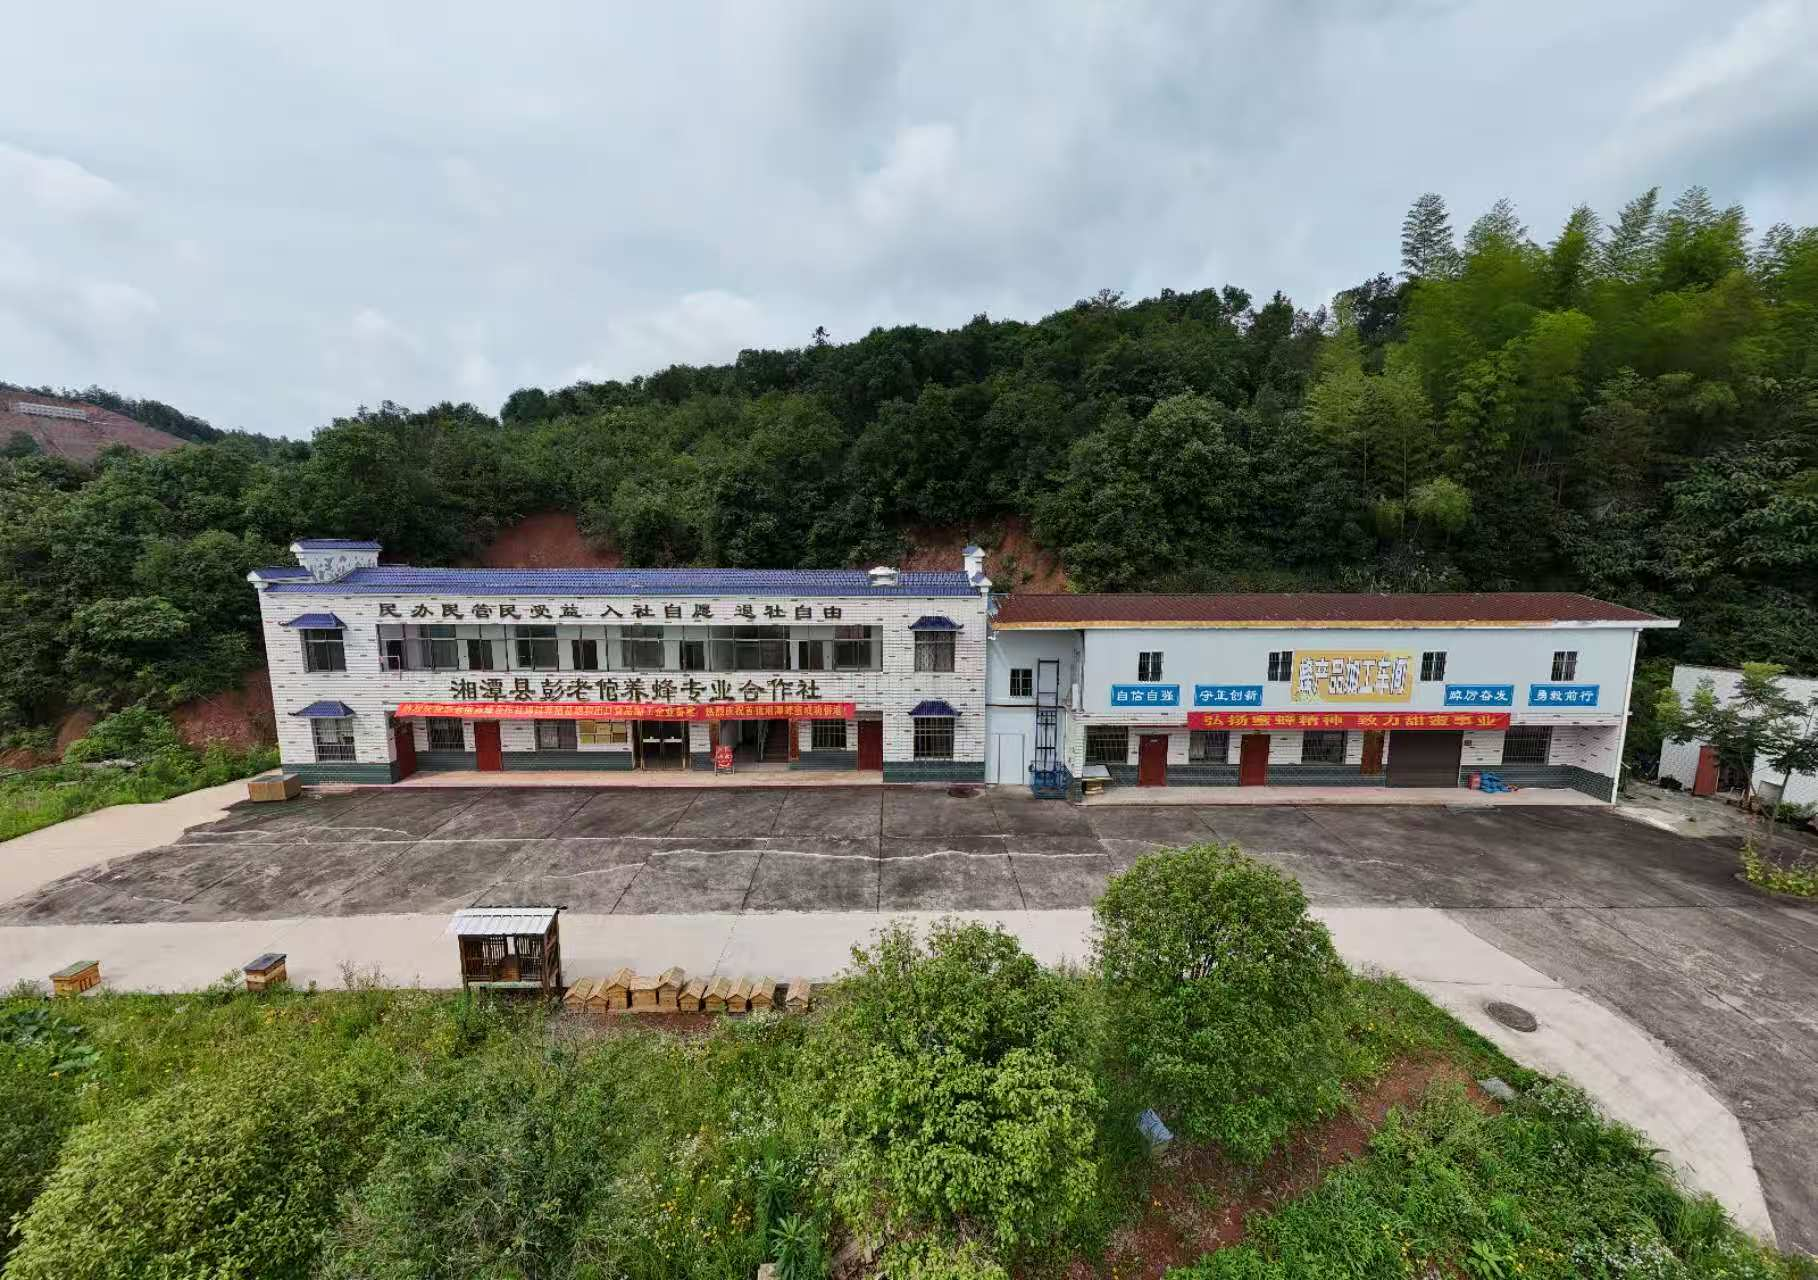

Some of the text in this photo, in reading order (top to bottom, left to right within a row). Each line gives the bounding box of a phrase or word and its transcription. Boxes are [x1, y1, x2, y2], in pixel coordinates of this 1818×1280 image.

[379, 603, 842, 619] 民办民管民受益 入社自愿 退社自由
[1299, 656, 1409, 695] 蜂产品加工车间
[450, 677, 822, 702] 湘潭县彭老佗养蜂专业合作社
[1116, 690, 1174, 701] 自信自强
[1199, 689, 1257, 701] 守正创新
[1448, 689, 1509, 701] 踔厉奋发
[1534, 689, 1595, 702] 勇毅前行
[1204, 714, 1497, 727] 弘扬蜜蜂精神 致力甜蜜事业
